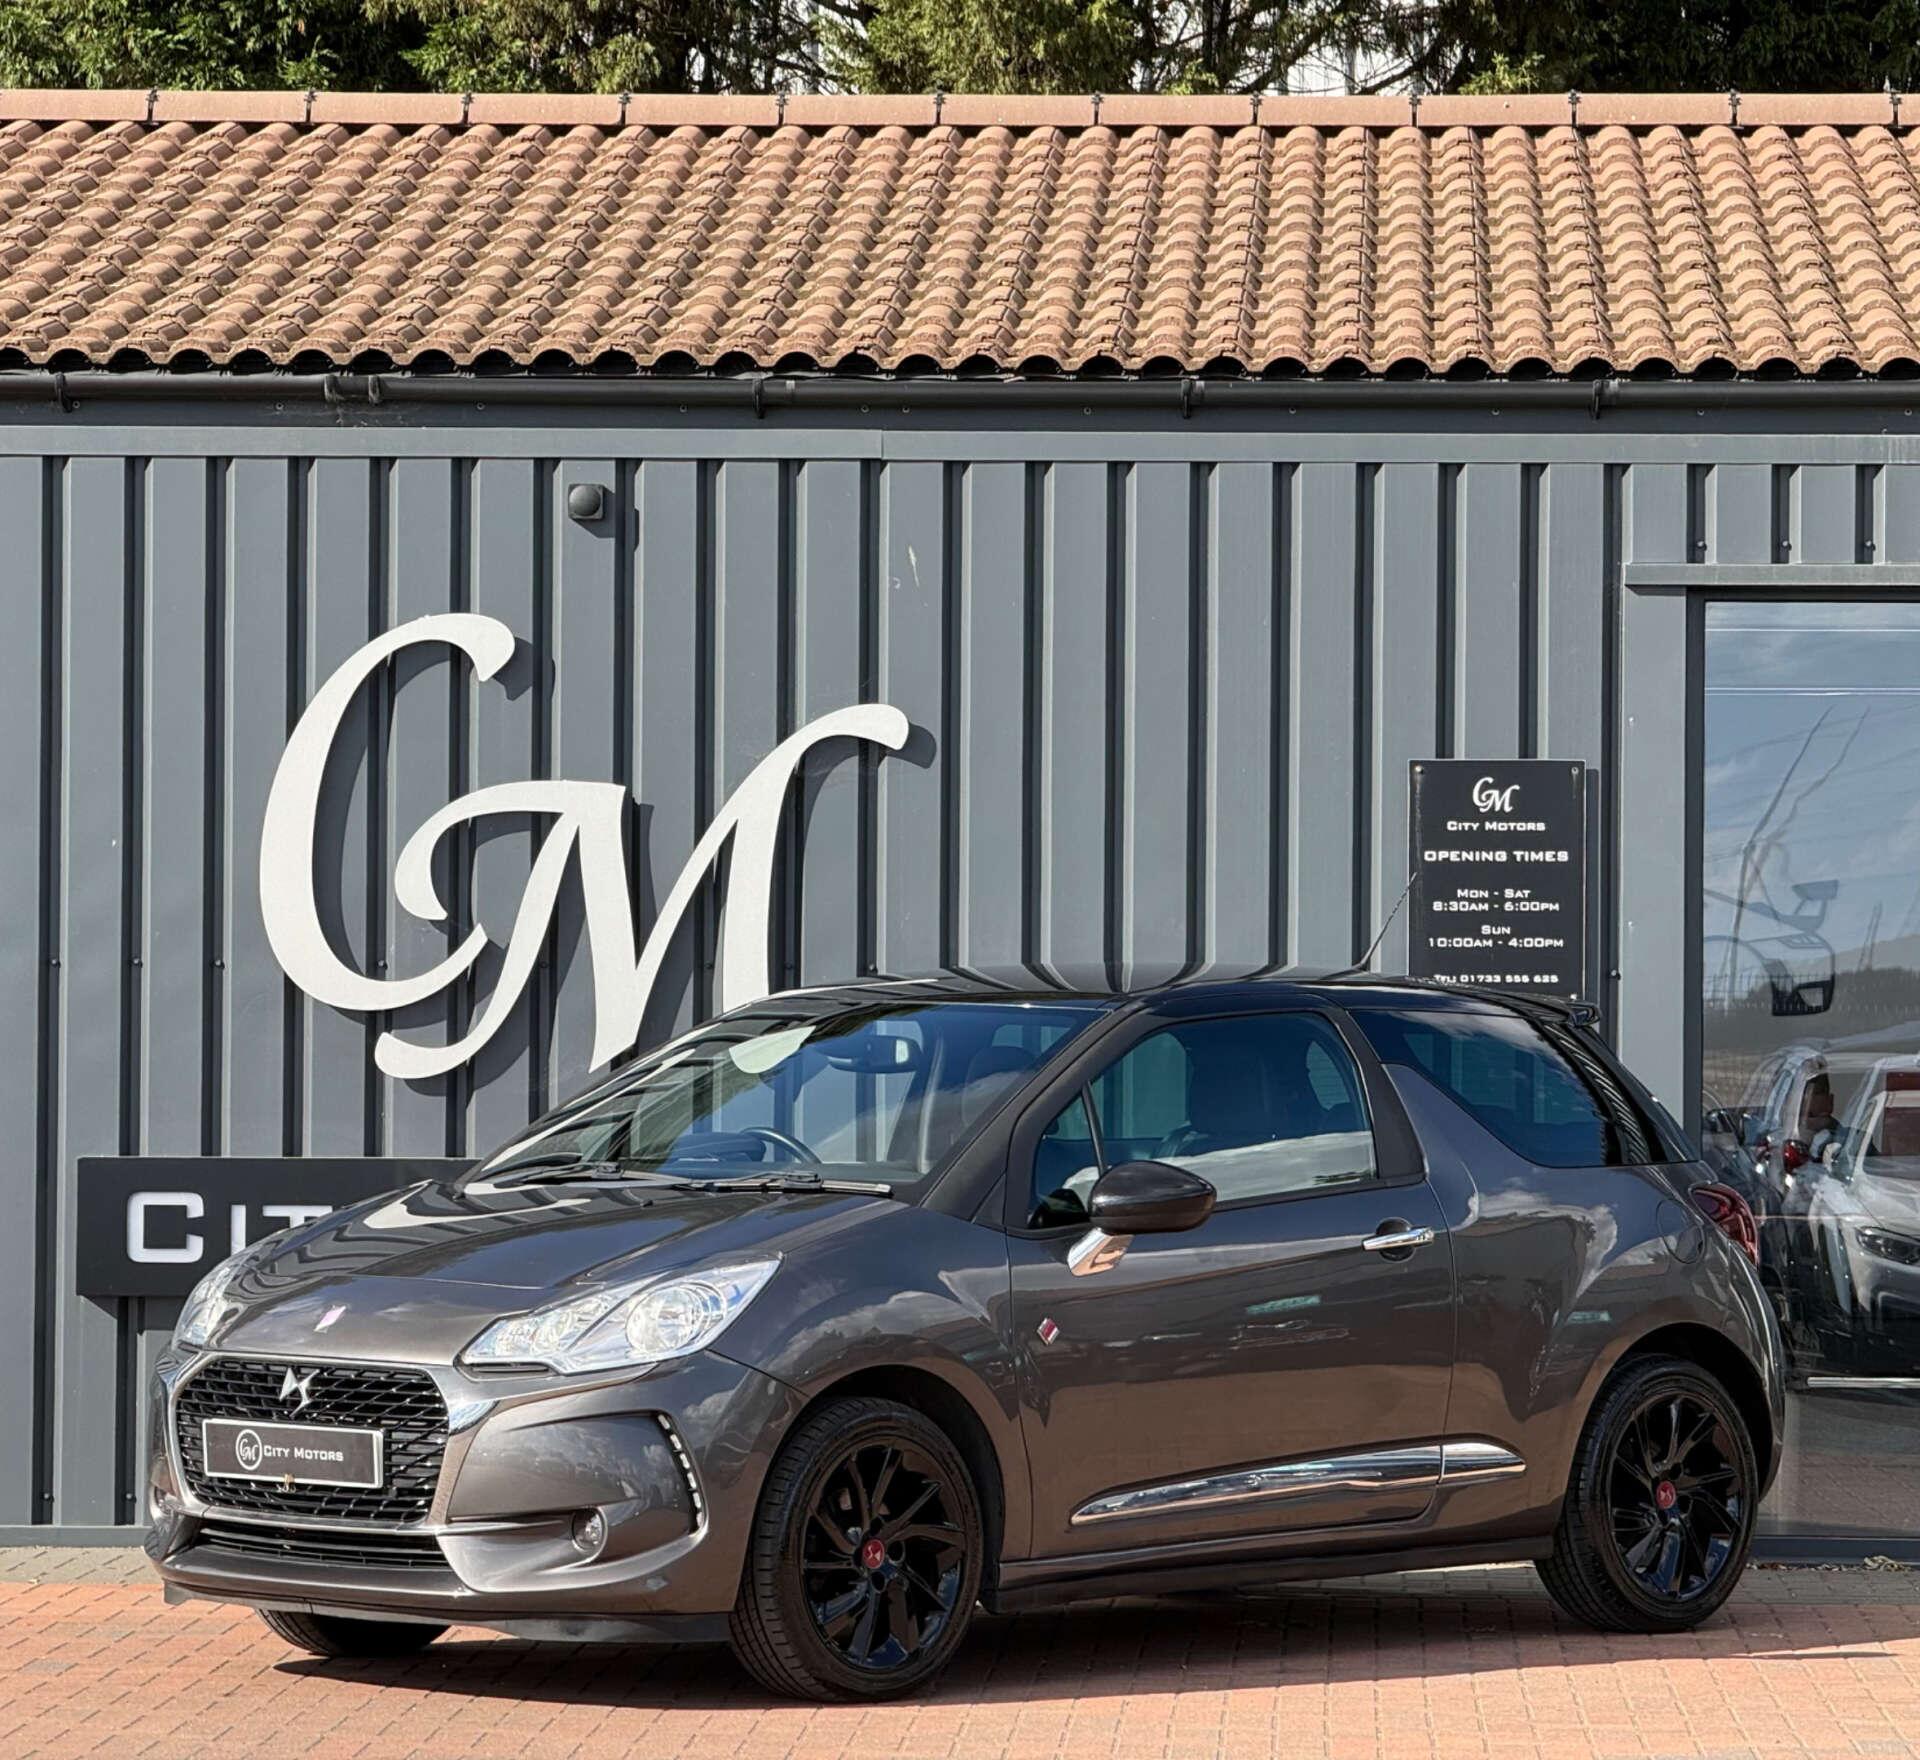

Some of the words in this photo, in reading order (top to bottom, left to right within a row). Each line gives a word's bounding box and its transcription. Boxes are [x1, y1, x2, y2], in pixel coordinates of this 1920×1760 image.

[1446, 820, 1480, 832] CITY
[1484, 820, 1546, 832] MOTORS
[1423, 850, 1508, 863] OPENING
[1512, 850, 1570, 863] TIMES
[1456, 888, 1489, 899] MON
[1503, 888, 1532, 899] SAT
[1480, 924, 1512, 936] SUN
[127, 1191, 334, 1264] CIT
